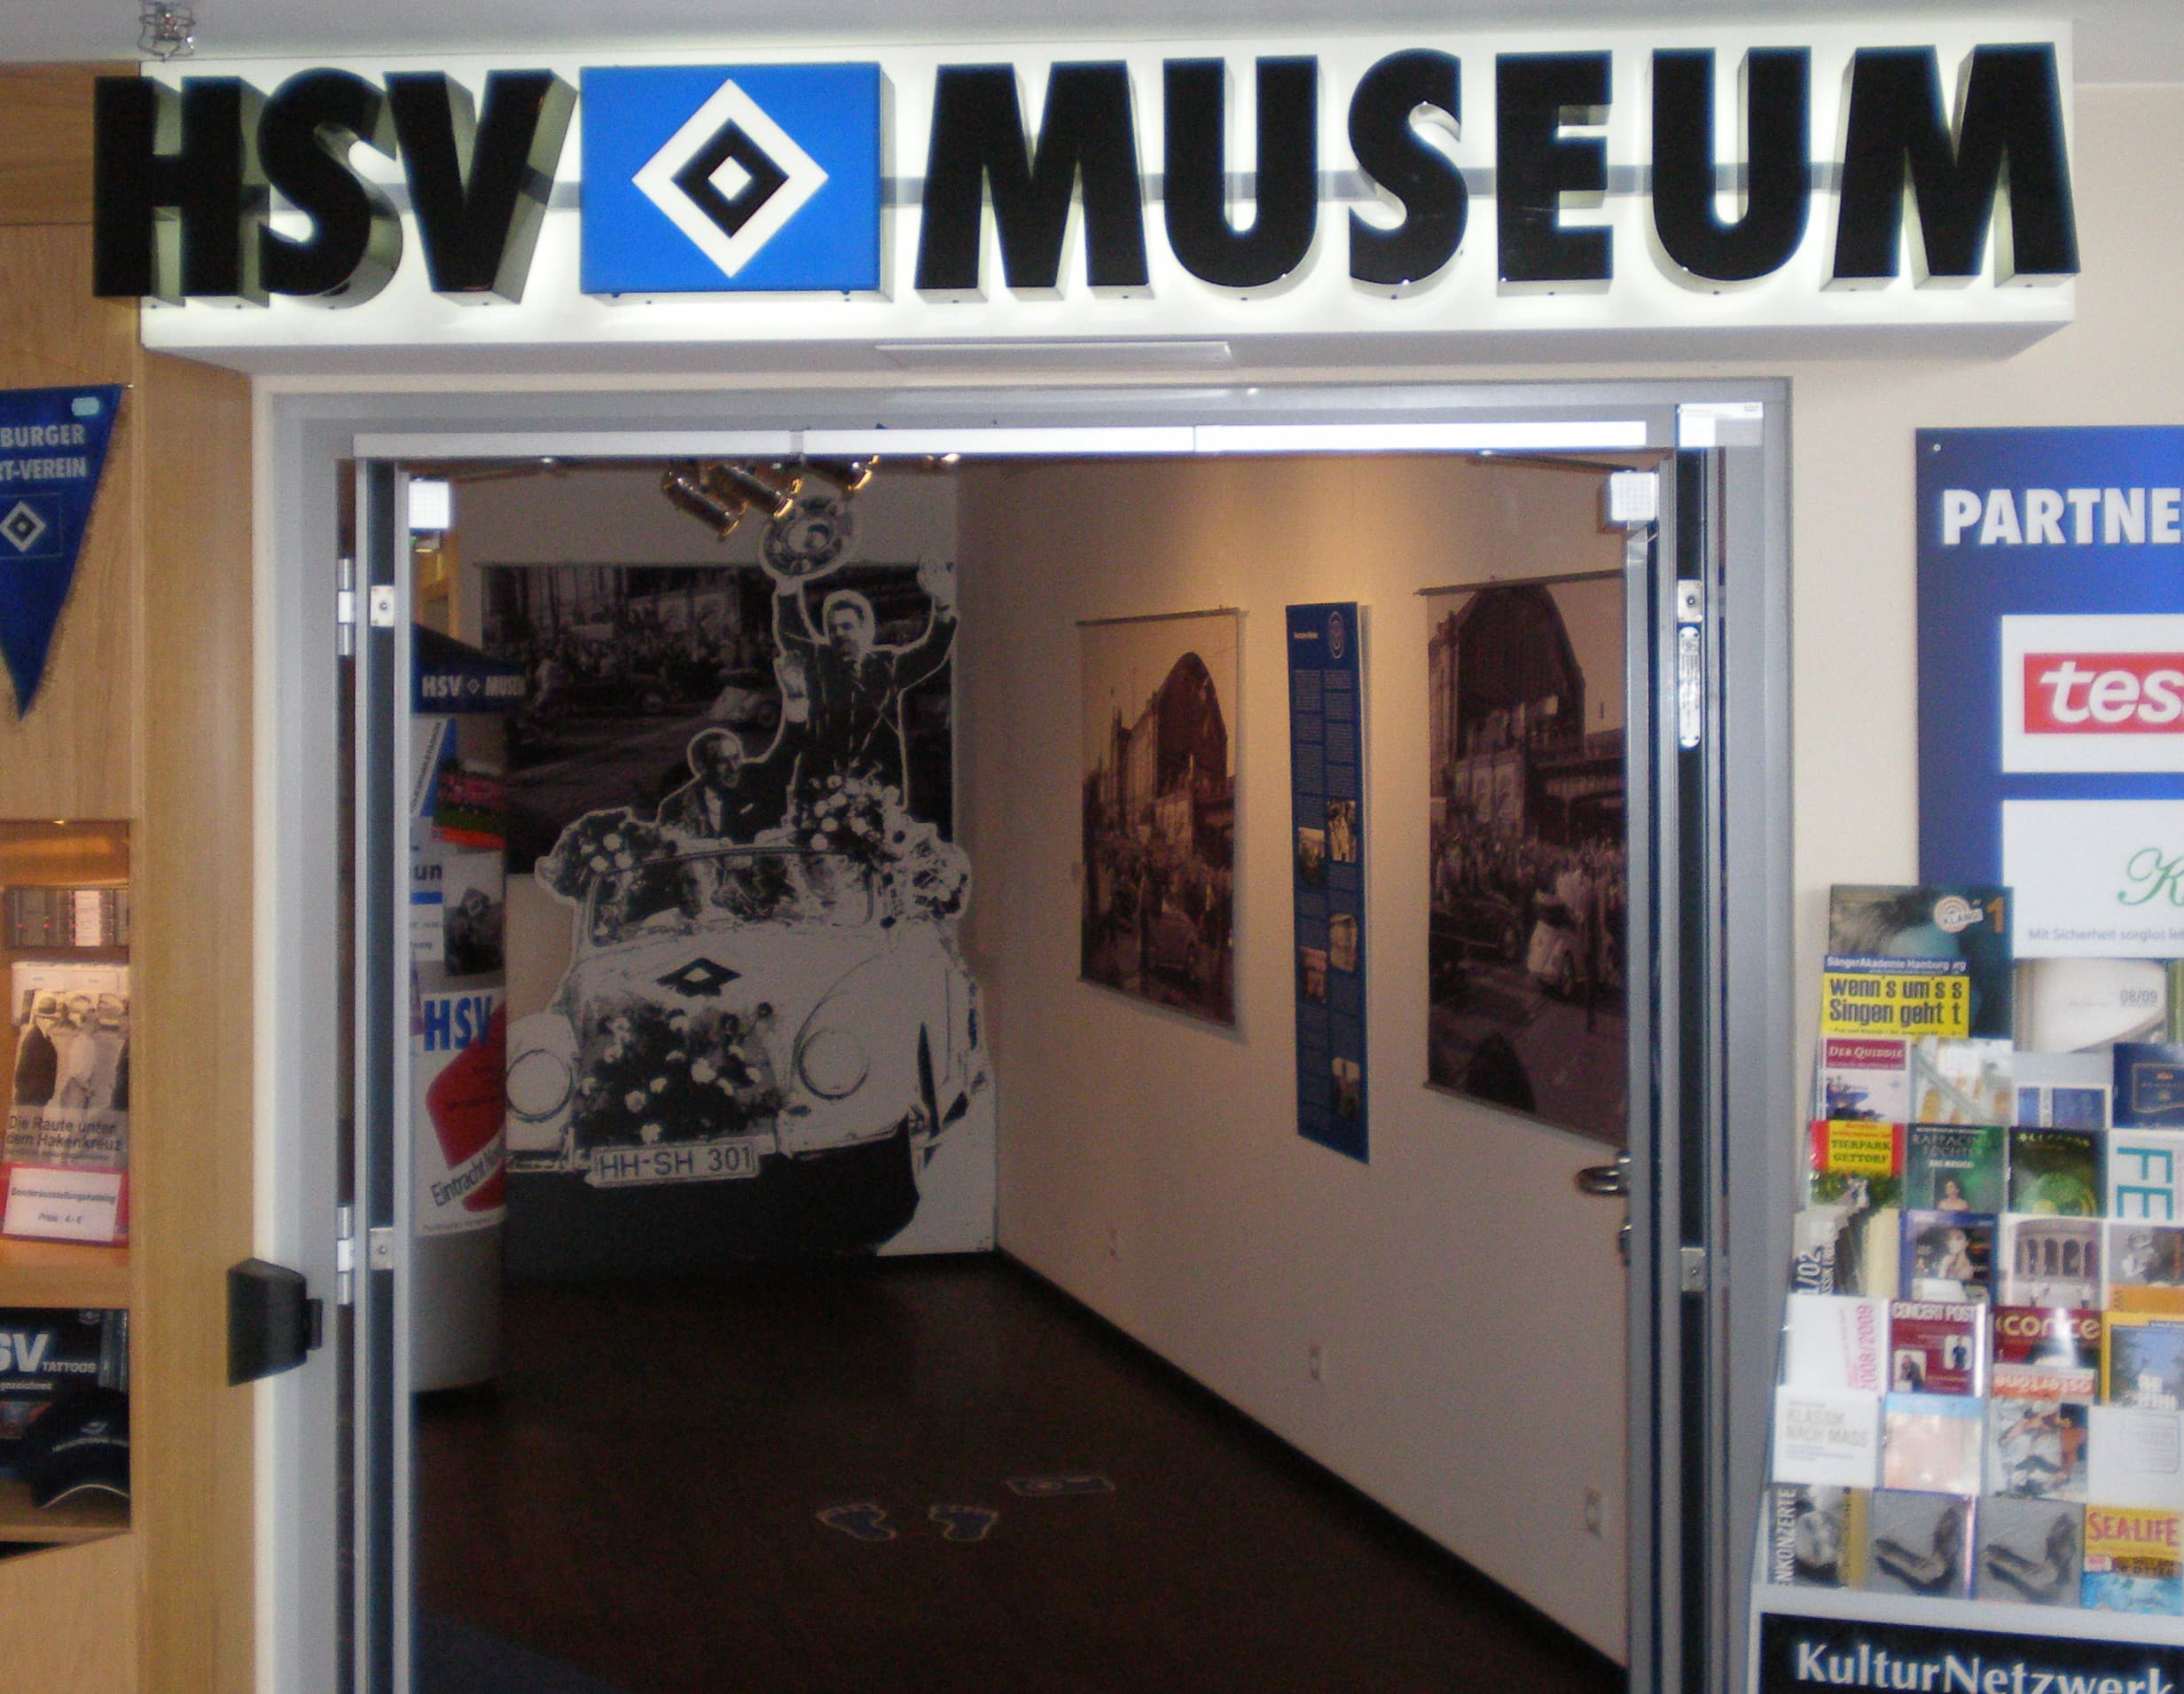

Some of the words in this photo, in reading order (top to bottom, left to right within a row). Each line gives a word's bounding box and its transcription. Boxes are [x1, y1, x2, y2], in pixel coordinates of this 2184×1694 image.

[93, 67, 568, 300] HSV
[914, 42, 2079, 293] MUSEUM
[0, 424, 85, 448] BURGER
[1943, 488, 2181, 545] PARTNE
[422, 675, 462, 697] HSV
[2040, 661, 2184, 725] tes
[424, 995, 492, 1052] HSV
[1829, 999, 1894, 1026] Singen
[1900, 1001, 1945, 1028] geht
[34, 1117, 74, 1132] Raute
[599, 1149, 693, 1180] HH-SH
[708, 1144, 751, 1172] 301
[43, 1361, 97, 1374] TATTOOS
[1797, 1642, 2174, 1694] KulturNetzwerk
